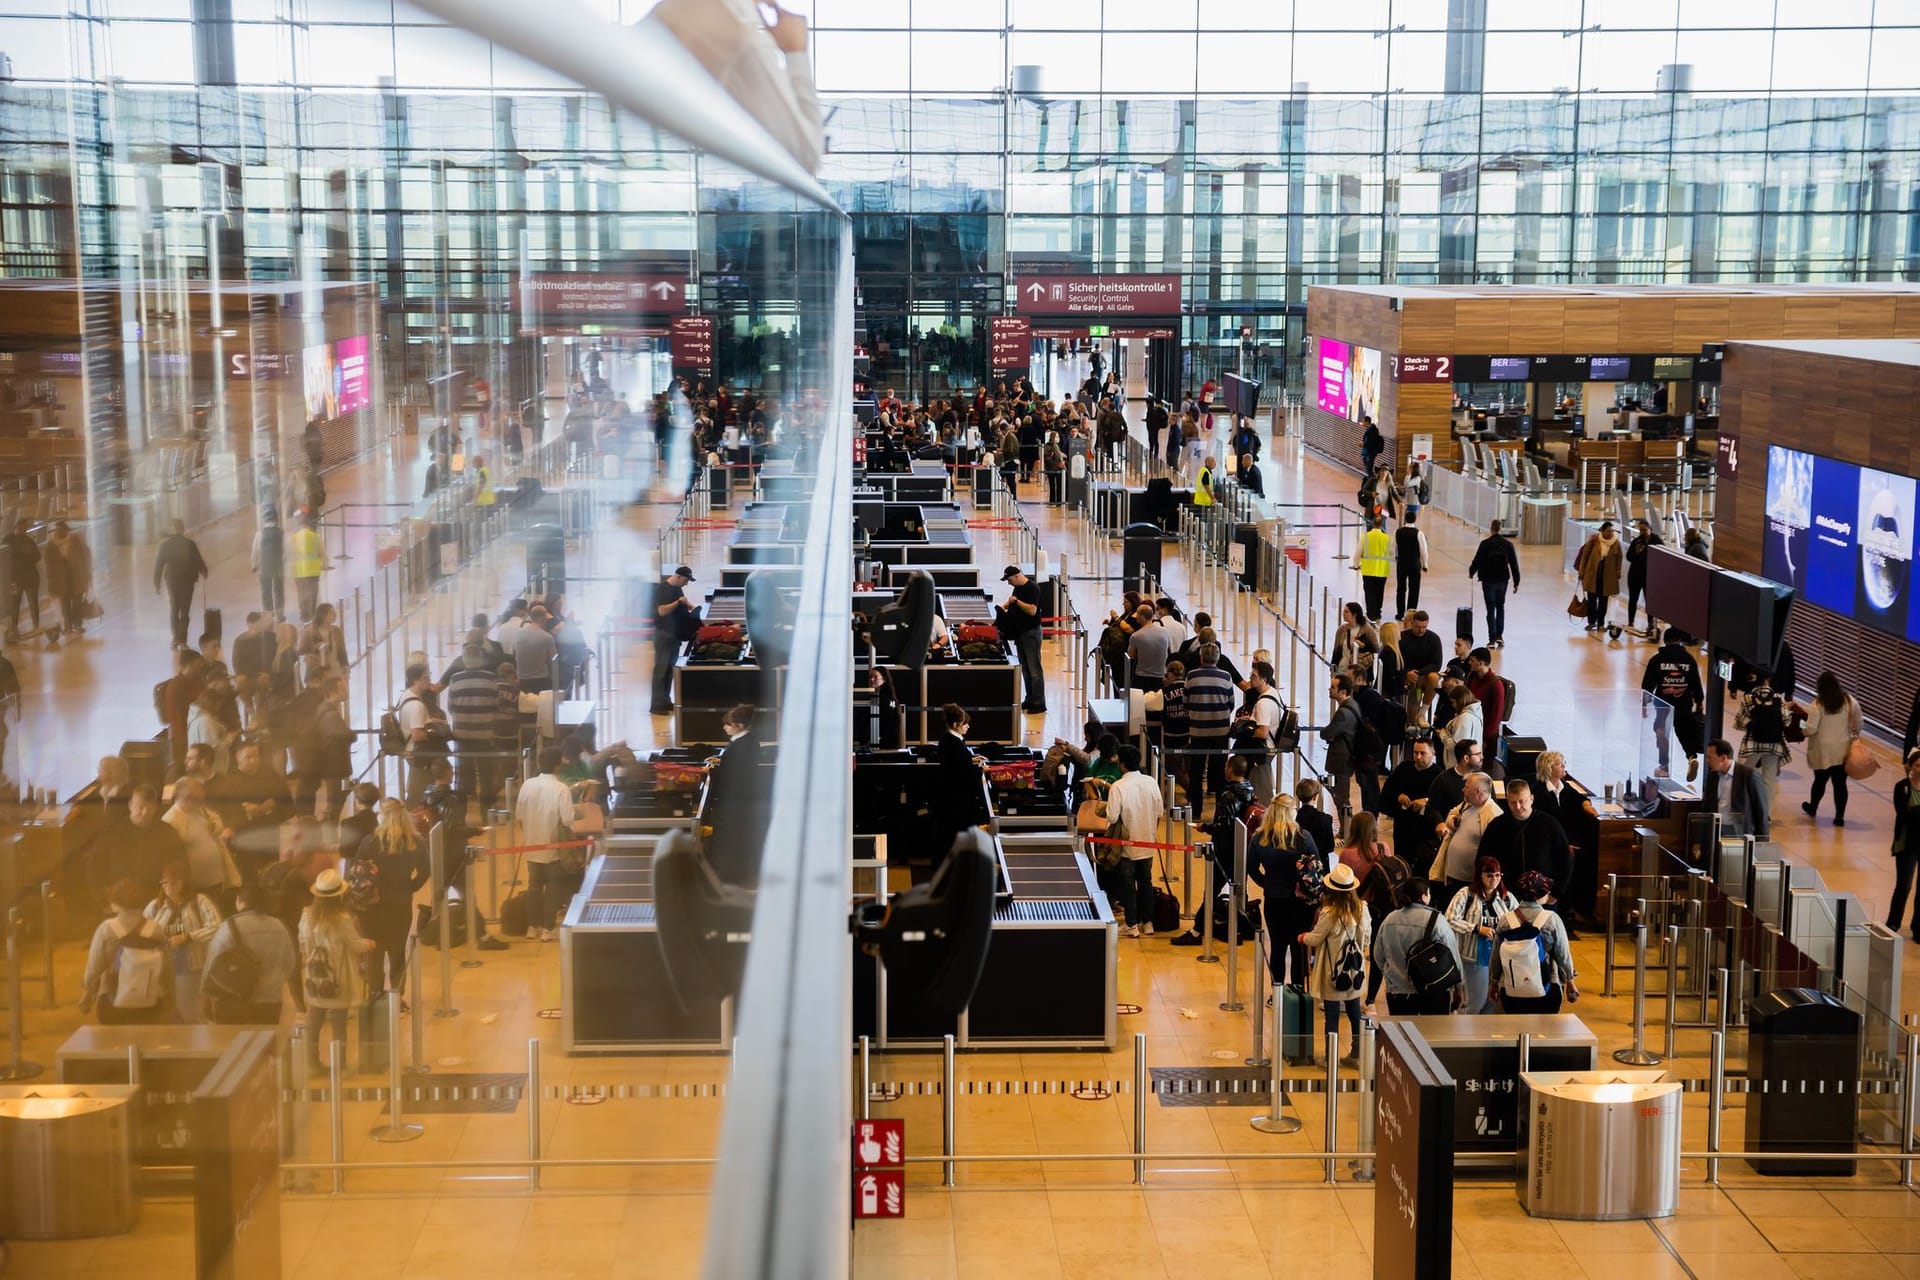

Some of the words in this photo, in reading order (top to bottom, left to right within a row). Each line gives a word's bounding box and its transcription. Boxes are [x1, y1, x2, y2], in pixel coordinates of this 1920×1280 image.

[1068, 282, 1166, 293] Sicherheitskontrolle
[1168, 283, 1173, 293] 1
[1068, 294, 1098, 304] Security
[1102, 294, 1130, 303] Control
[1068, 304, 1082, 312] Alle
[1083, 304, 1104, 312] Gates
[1107, 304, 1116, 312] All
[1116, 304, 1135, 312] Gates
[1490, 358, 1509, 367] BER
[1591, 358, 1609, 367] BER
[1654, 357, 1673, 367] BER
[1435, 357, 1450, 378] 2
[1728, 439, 1738, 472] 4
[1465, 1079, 1515, 1094] Security
